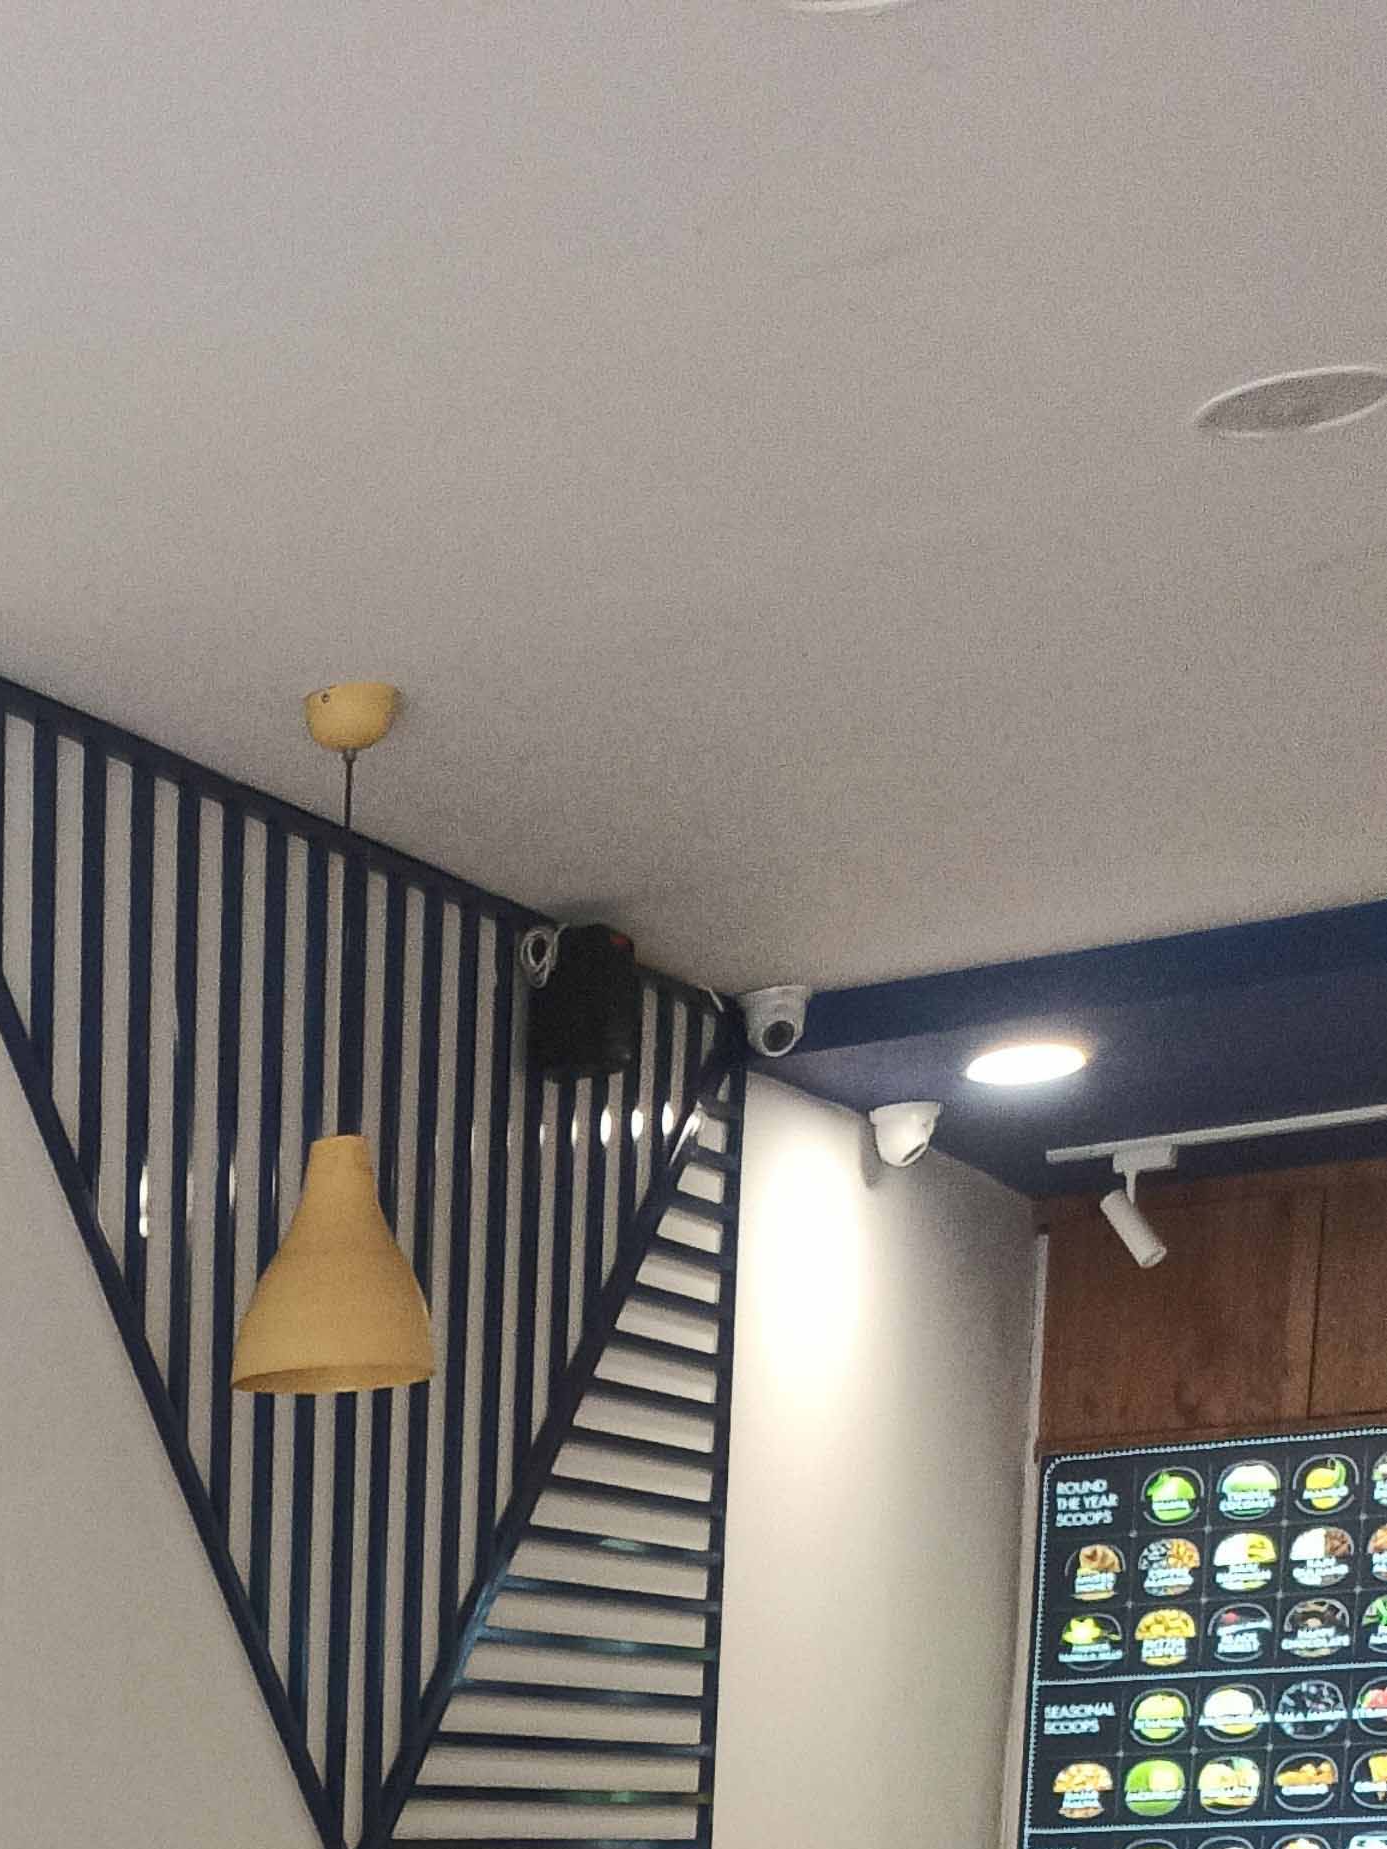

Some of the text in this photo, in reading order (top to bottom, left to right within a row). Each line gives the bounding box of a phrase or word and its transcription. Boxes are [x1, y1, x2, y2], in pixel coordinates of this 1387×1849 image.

[1056, 1479, 1108, 1495] ROUND
[1057, 1492, 1119, 1511] THE YEAR
[1055, 1510, 1114, 1527] SCOOPS
[1044, 1702, 1115, 1719] SEASONAL
